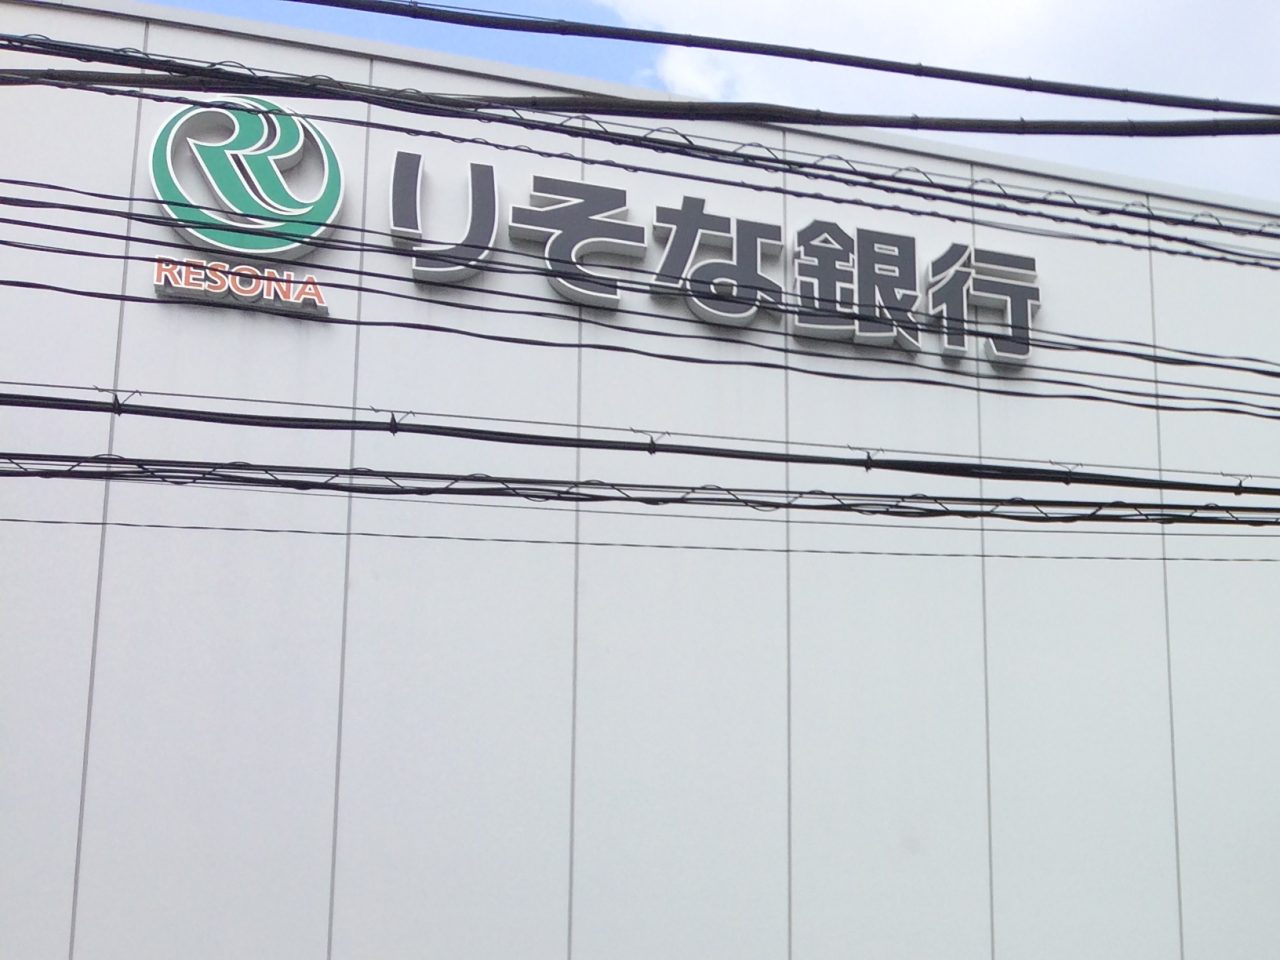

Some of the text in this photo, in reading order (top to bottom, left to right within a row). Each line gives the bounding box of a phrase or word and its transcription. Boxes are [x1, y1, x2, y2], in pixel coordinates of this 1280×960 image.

[153, 255, 328, 307] RESONA
[389, 150, 1042, 358] りそな銀行
